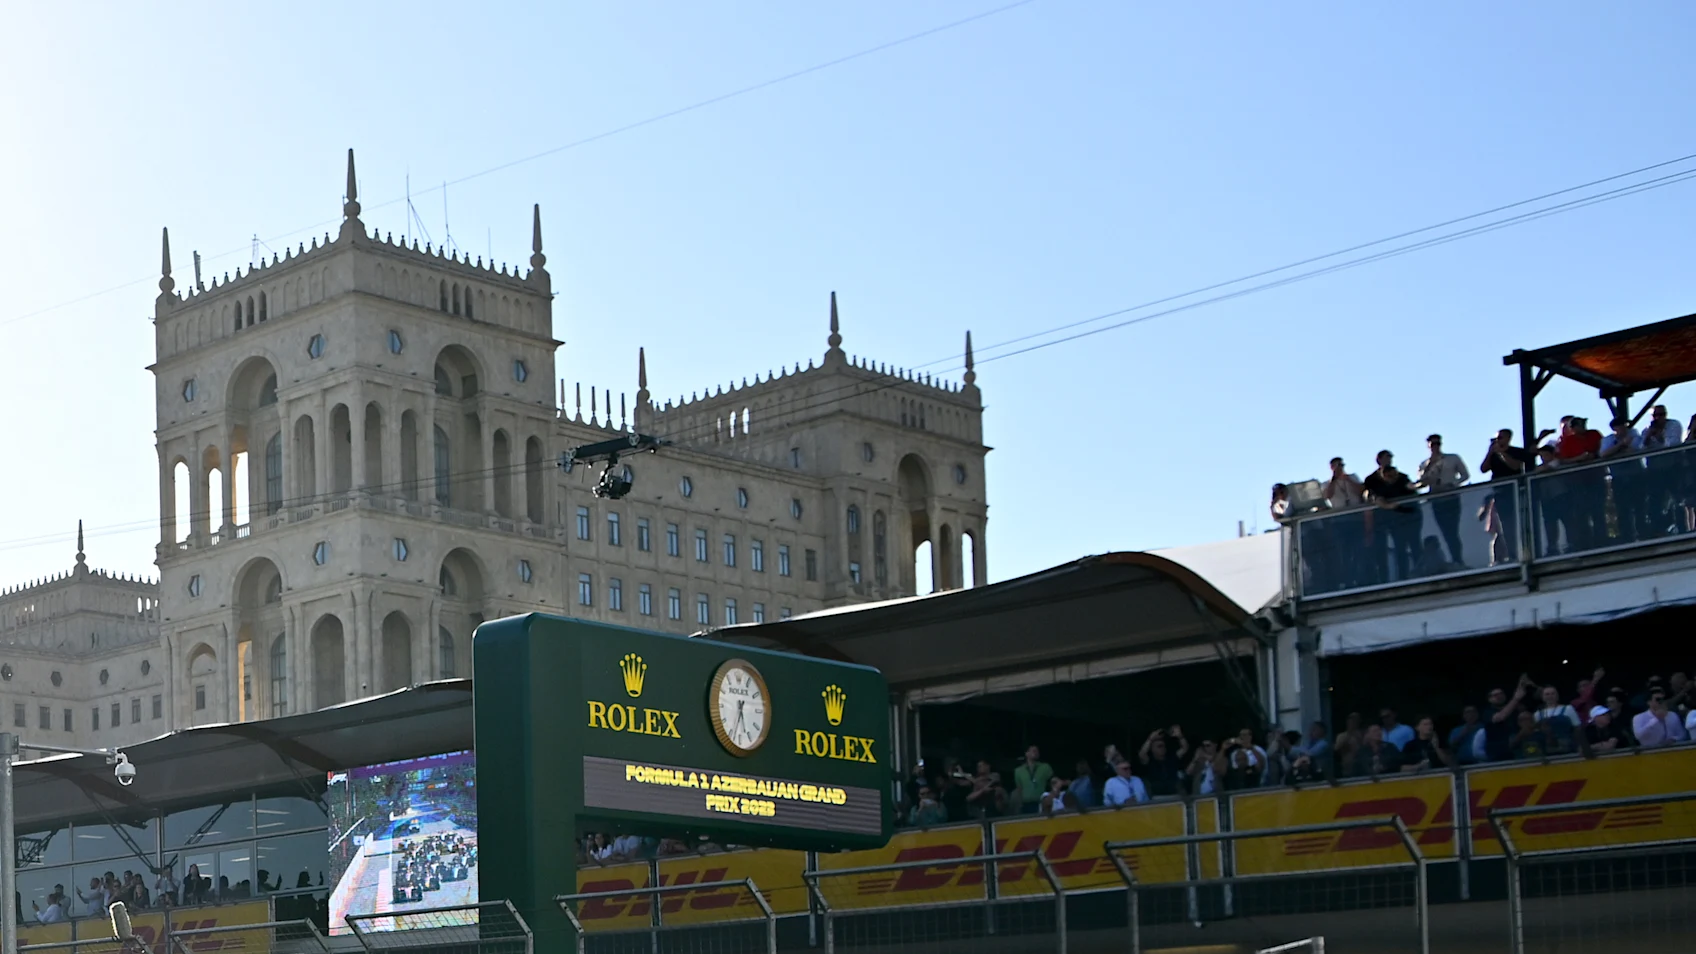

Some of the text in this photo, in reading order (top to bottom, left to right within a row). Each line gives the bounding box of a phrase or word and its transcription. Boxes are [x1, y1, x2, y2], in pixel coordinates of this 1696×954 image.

[728, 686, 750, 698] ROLEX
[587, 700, 681, 738] ROLEX
[793, 729, 877, 763] ROLEX
[625, 764, 847, 805] FORMULA 1 AZERBAIJAN GRAND
[705, 794, 776, 817] PRIX 2023
[1333, 778, 1607, 852] DHL
[892, 830, 1100, 896] DHL
[578, 867, 744, 920] DHL
